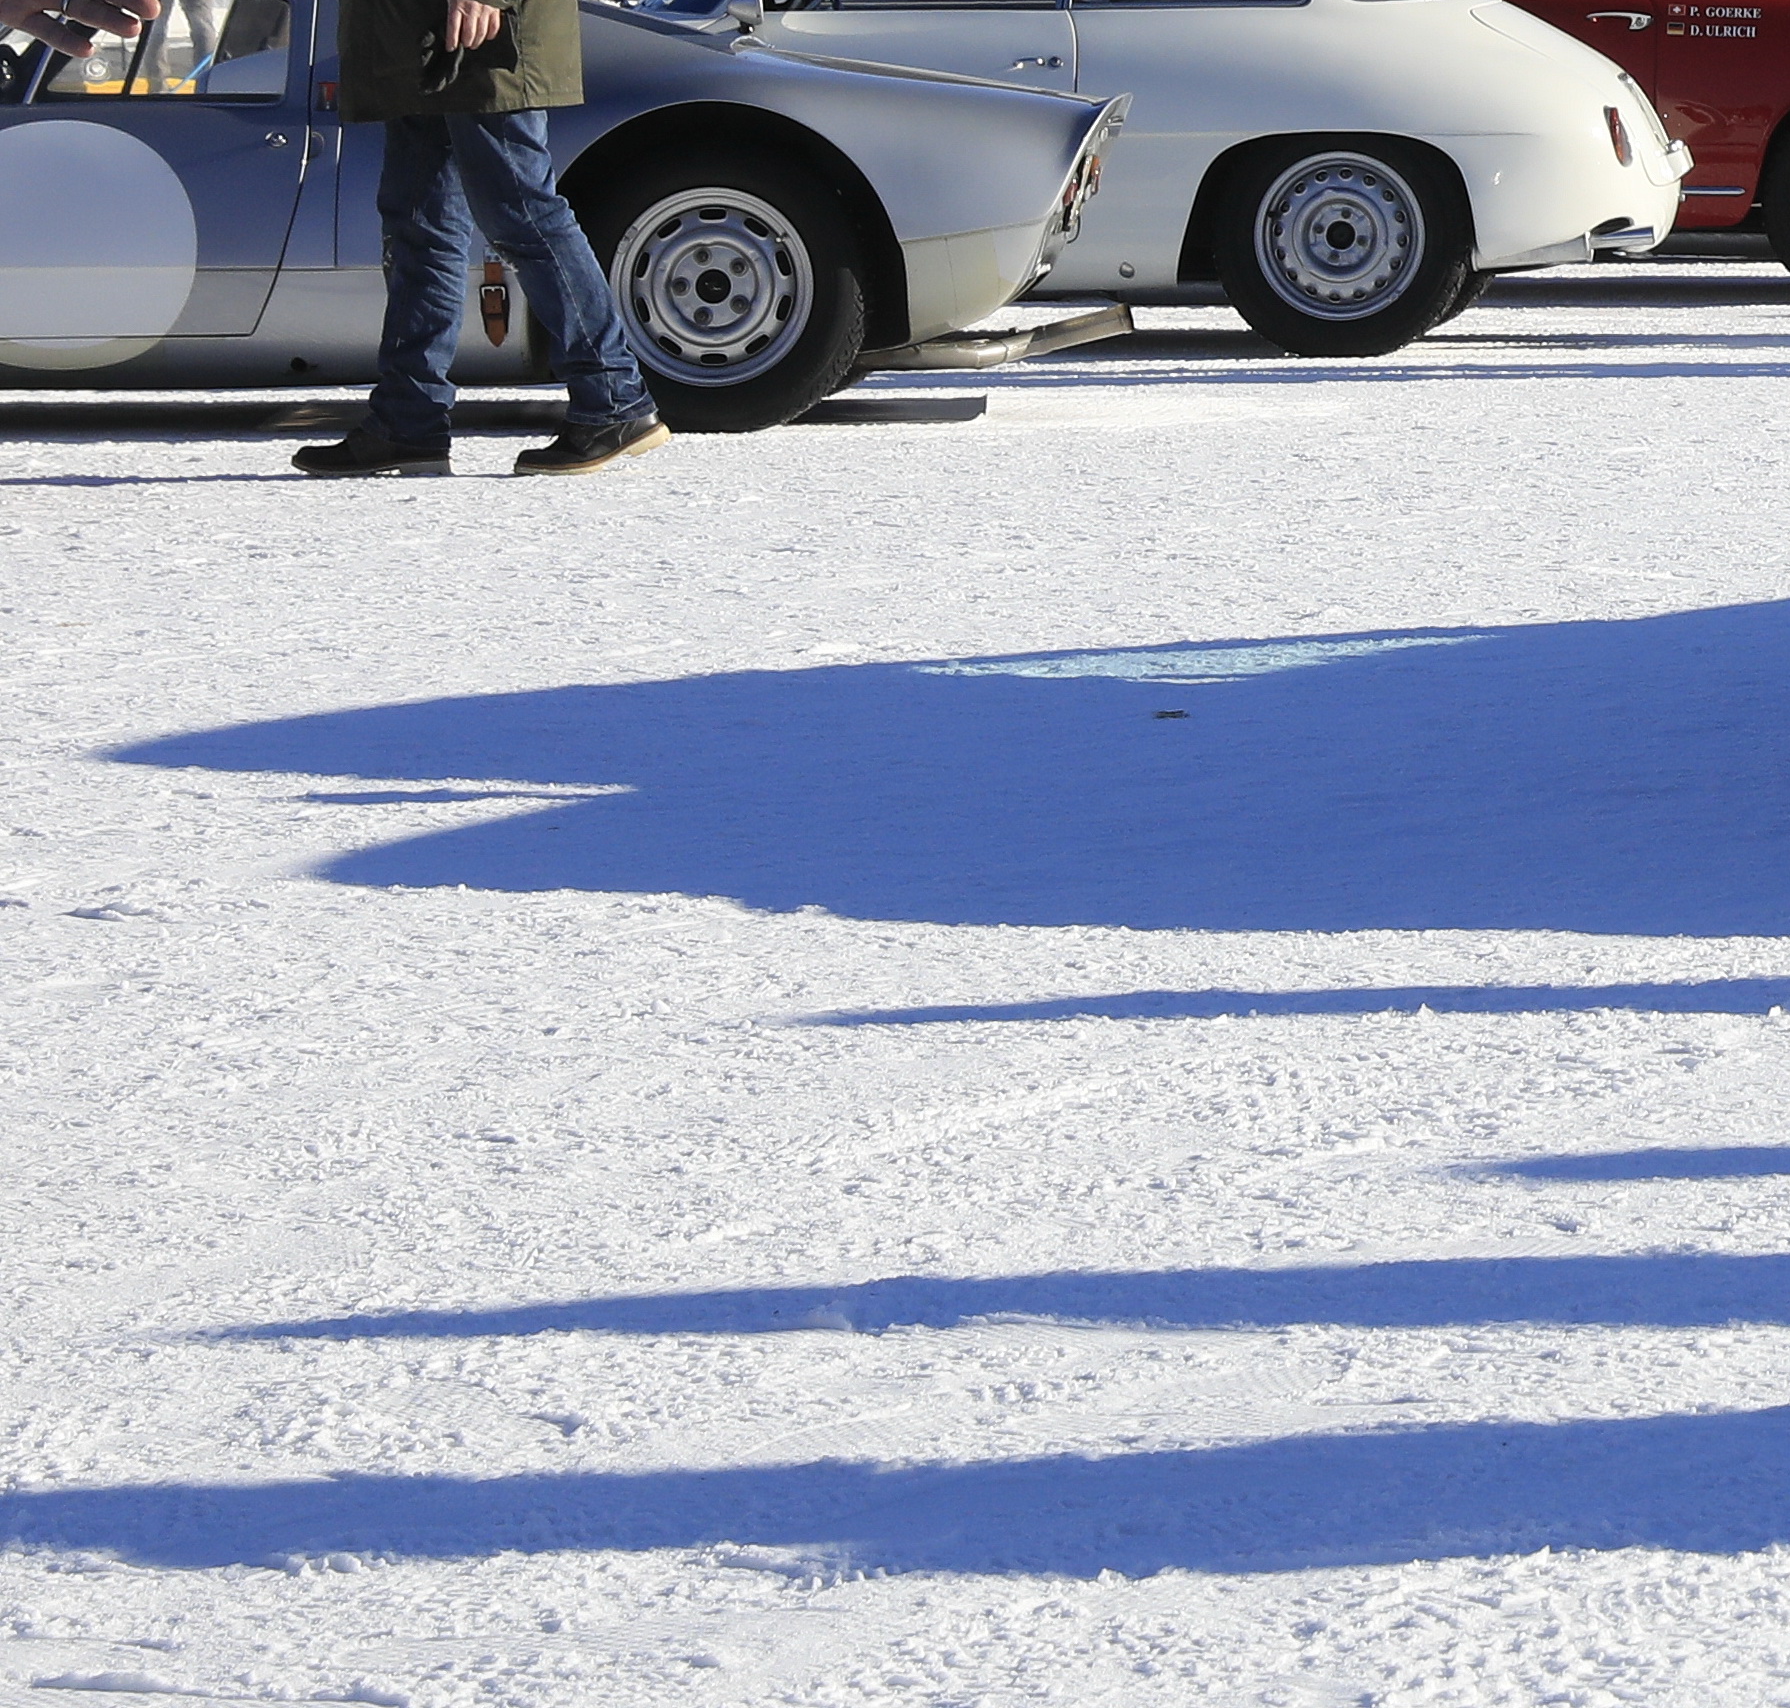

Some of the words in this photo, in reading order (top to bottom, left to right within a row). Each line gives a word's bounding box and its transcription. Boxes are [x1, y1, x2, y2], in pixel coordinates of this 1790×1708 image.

[1690, 6, 1700, 17] P.
[1705, 6, 1762, 19] GOERKE
[1690, 25, 1703, 37] D.
[1705, 25, 1756, 38] ULRICH
